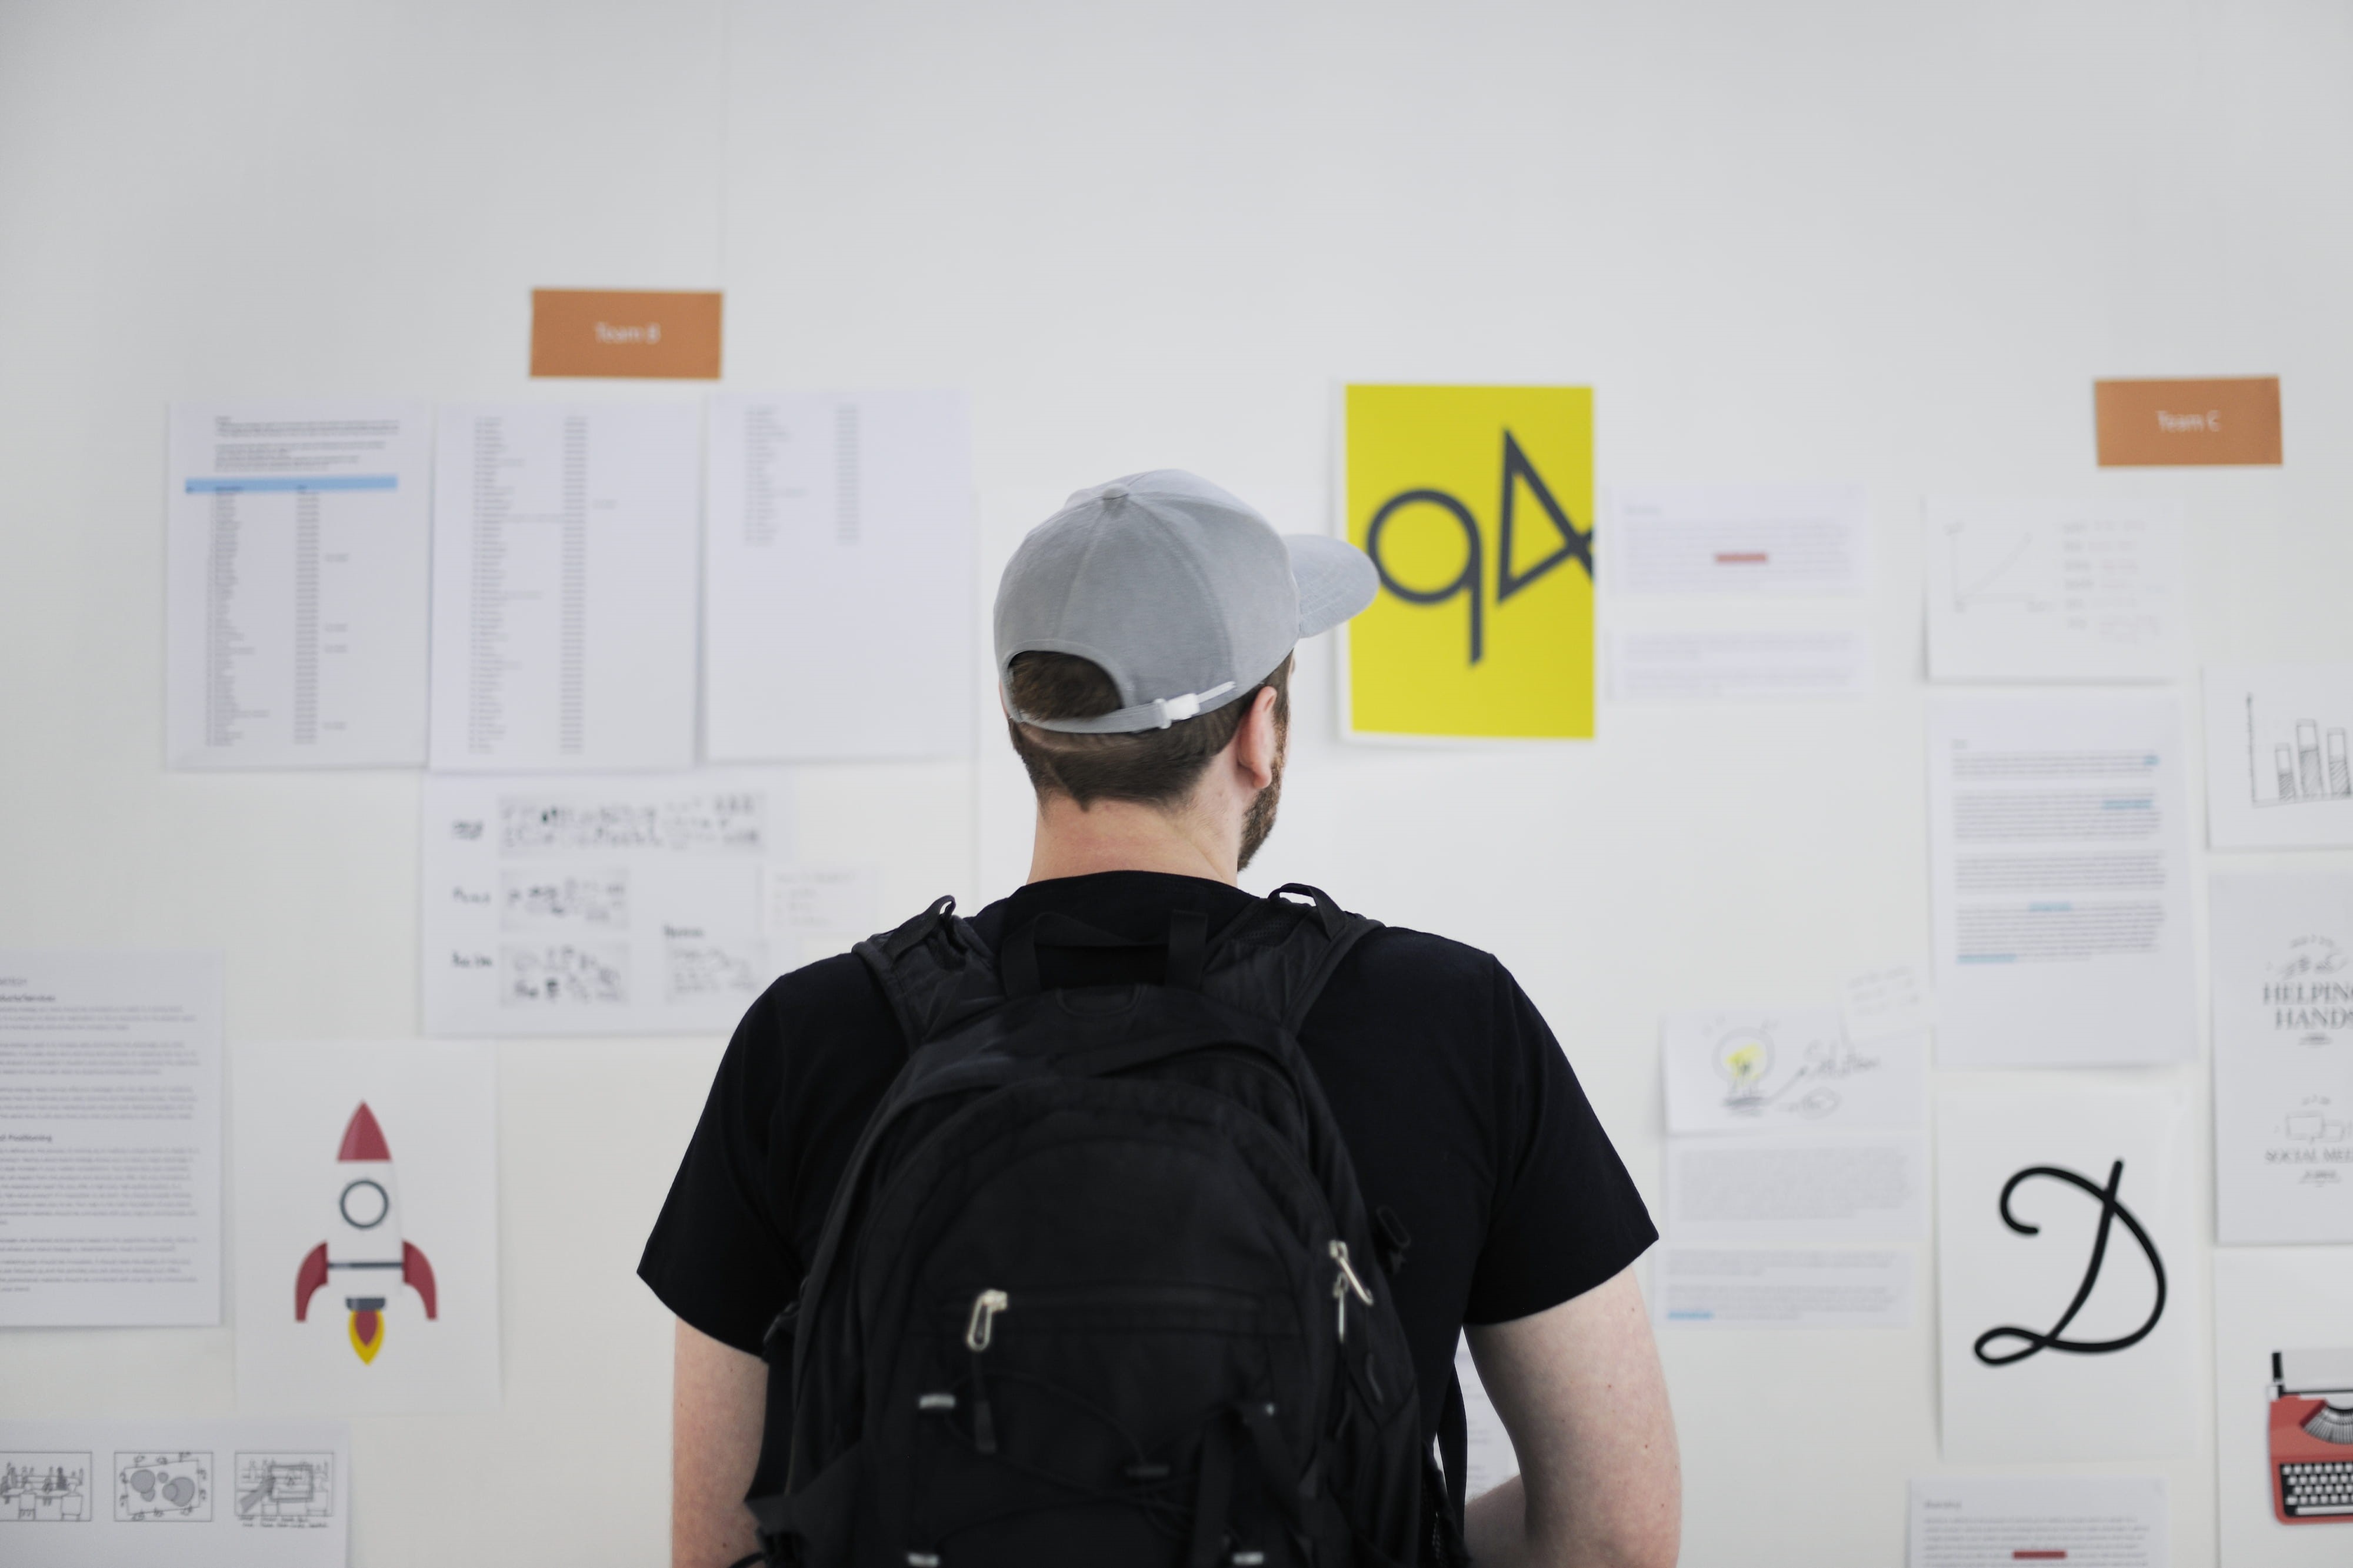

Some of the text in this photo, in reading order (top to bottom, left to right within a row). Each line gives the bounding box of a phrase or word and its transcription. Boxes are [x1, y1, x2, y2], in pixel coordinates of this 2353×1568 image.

[595, 322, 645, 343] Team
[2156, 410, 2221, 432] Team C
[2263, 981, 2353, 1005] HELPIN
[1974, 1159, 2167, 1367] D
